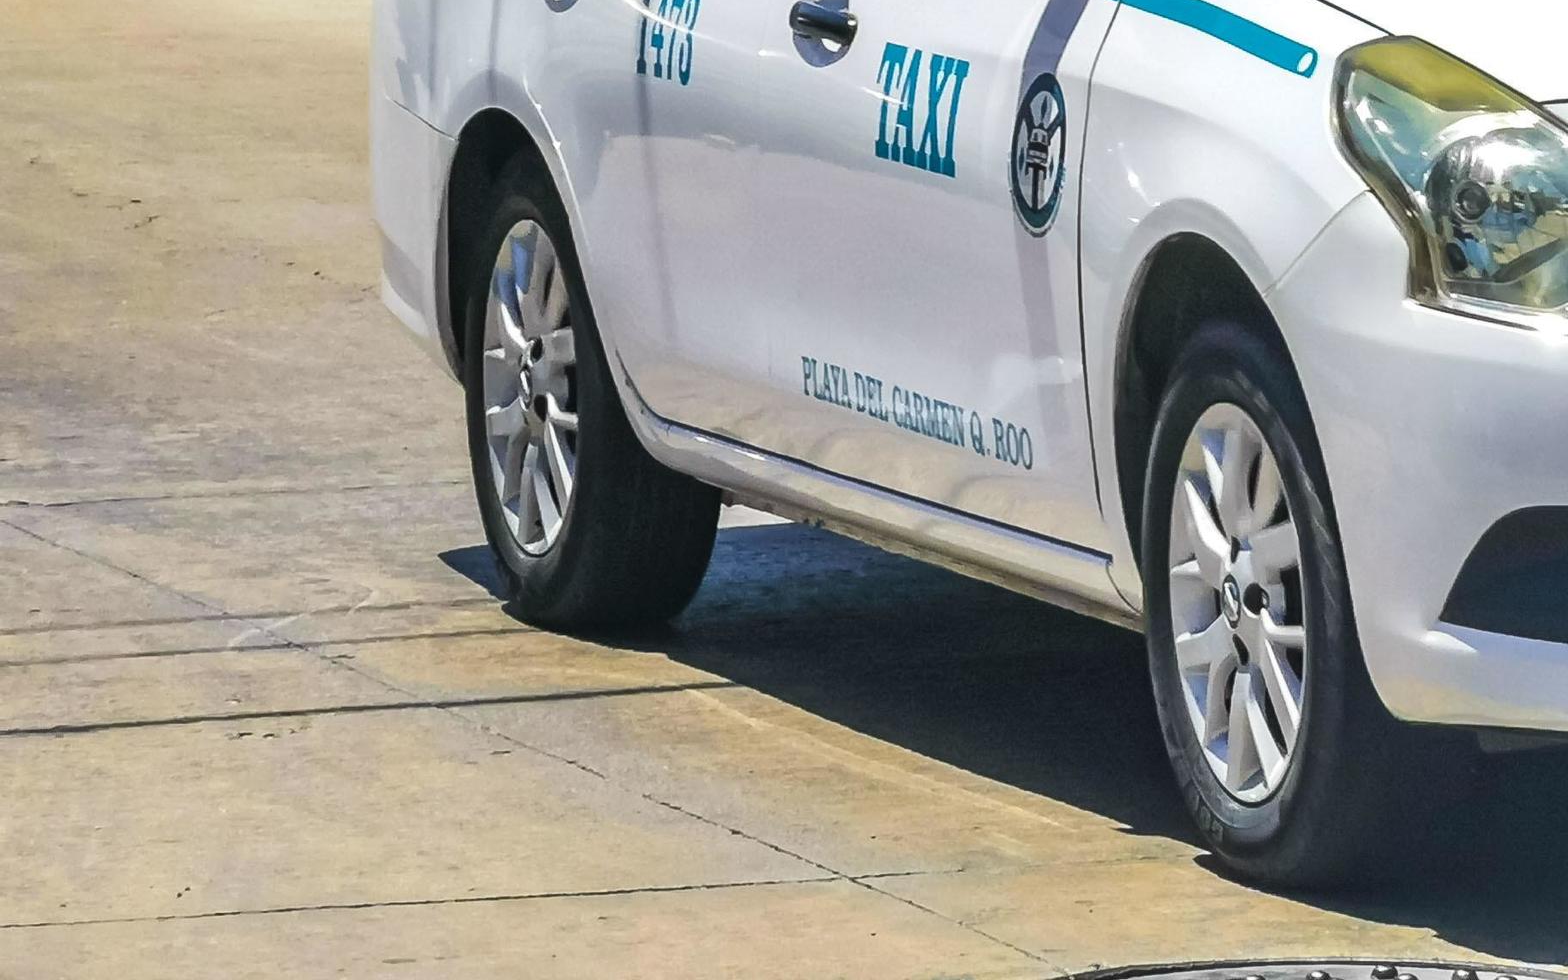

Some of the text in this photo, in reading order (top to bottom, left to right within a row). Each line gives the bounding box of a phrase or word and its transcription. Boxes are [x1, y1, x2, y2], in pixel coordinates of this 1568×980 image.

[875, 42, 970, 179] TAXI
[801, 356, 1033, 470] PLAYA DEL CARMEN Q. ROO
